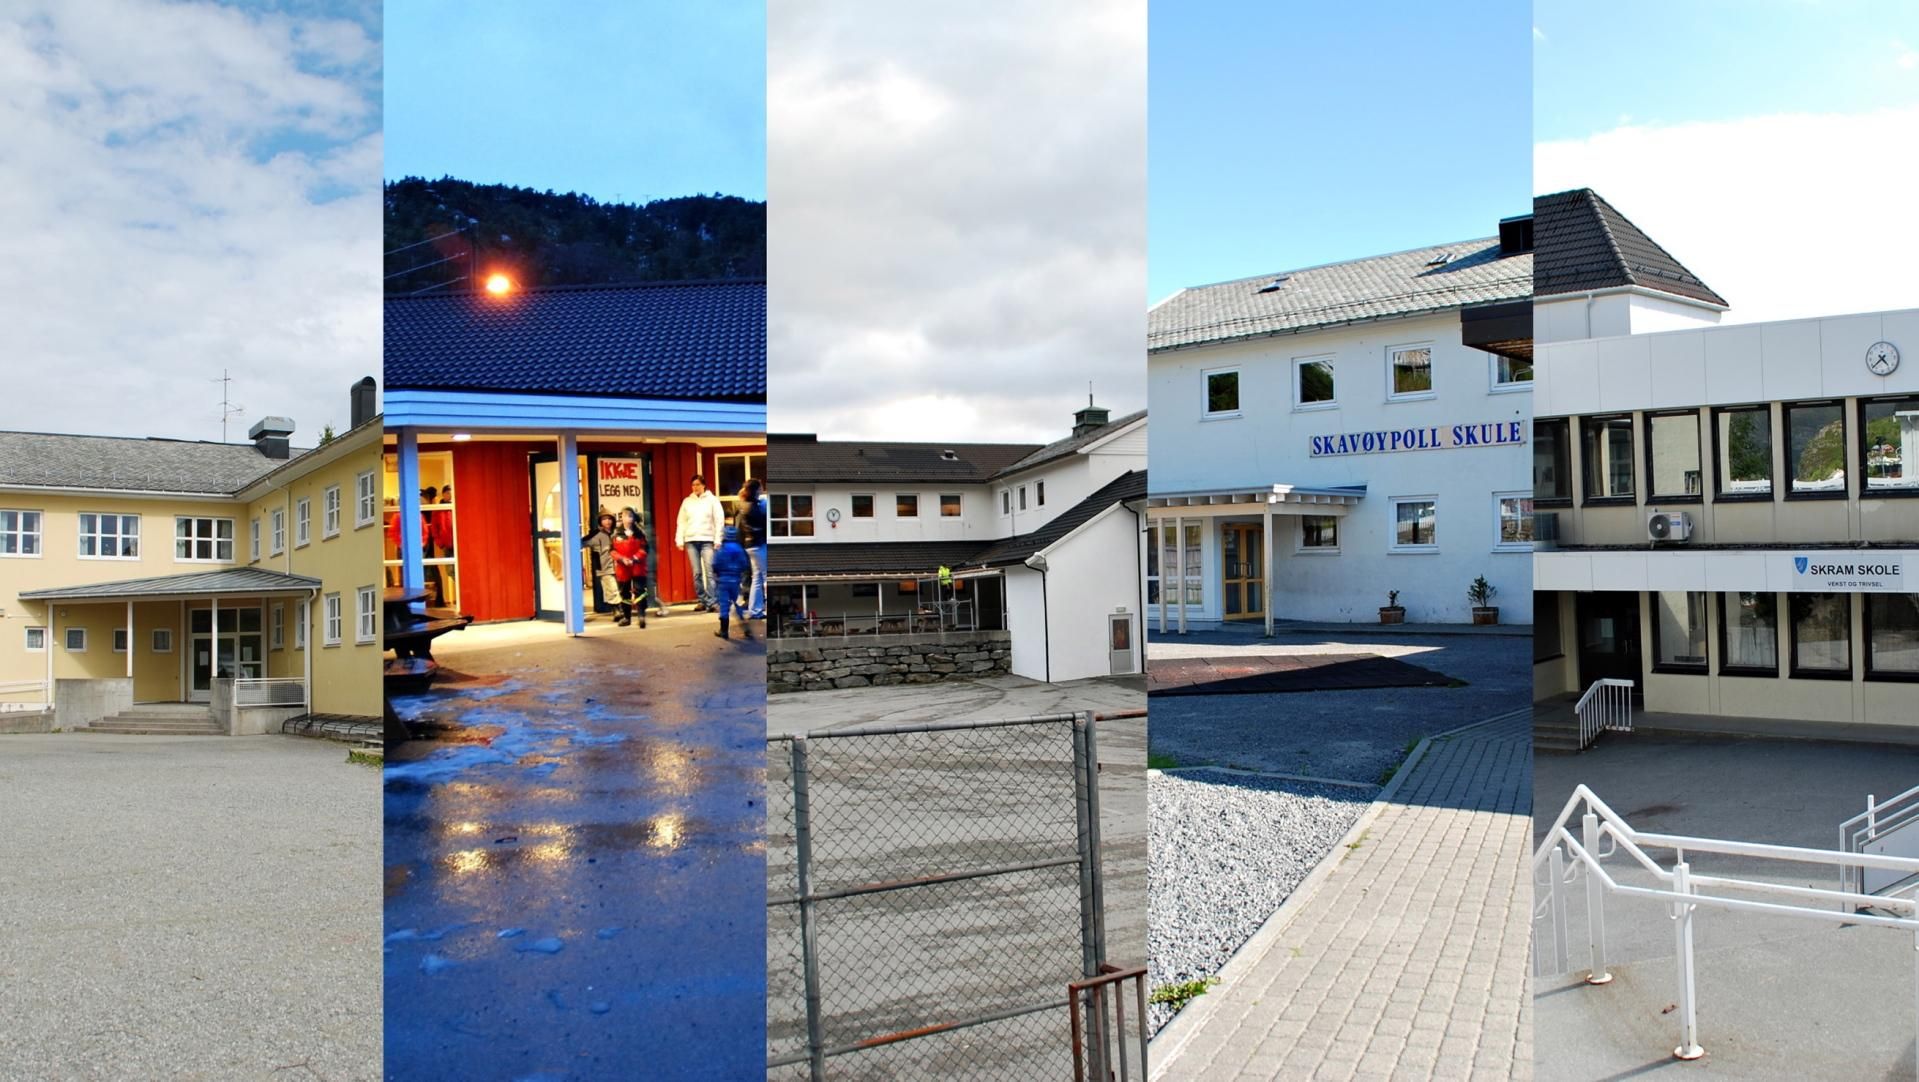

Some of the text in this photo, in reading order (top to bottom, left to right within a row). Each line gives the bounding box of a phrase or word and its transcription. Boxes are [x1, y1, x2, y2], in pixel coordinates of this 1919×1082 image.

[1313, 421, 1521, 455] SKAVØYPOLL SKULE
[600, 484, 641, 497] LEGG NED
[1810, 564, 1900, 575] SKRAM SKOLE
